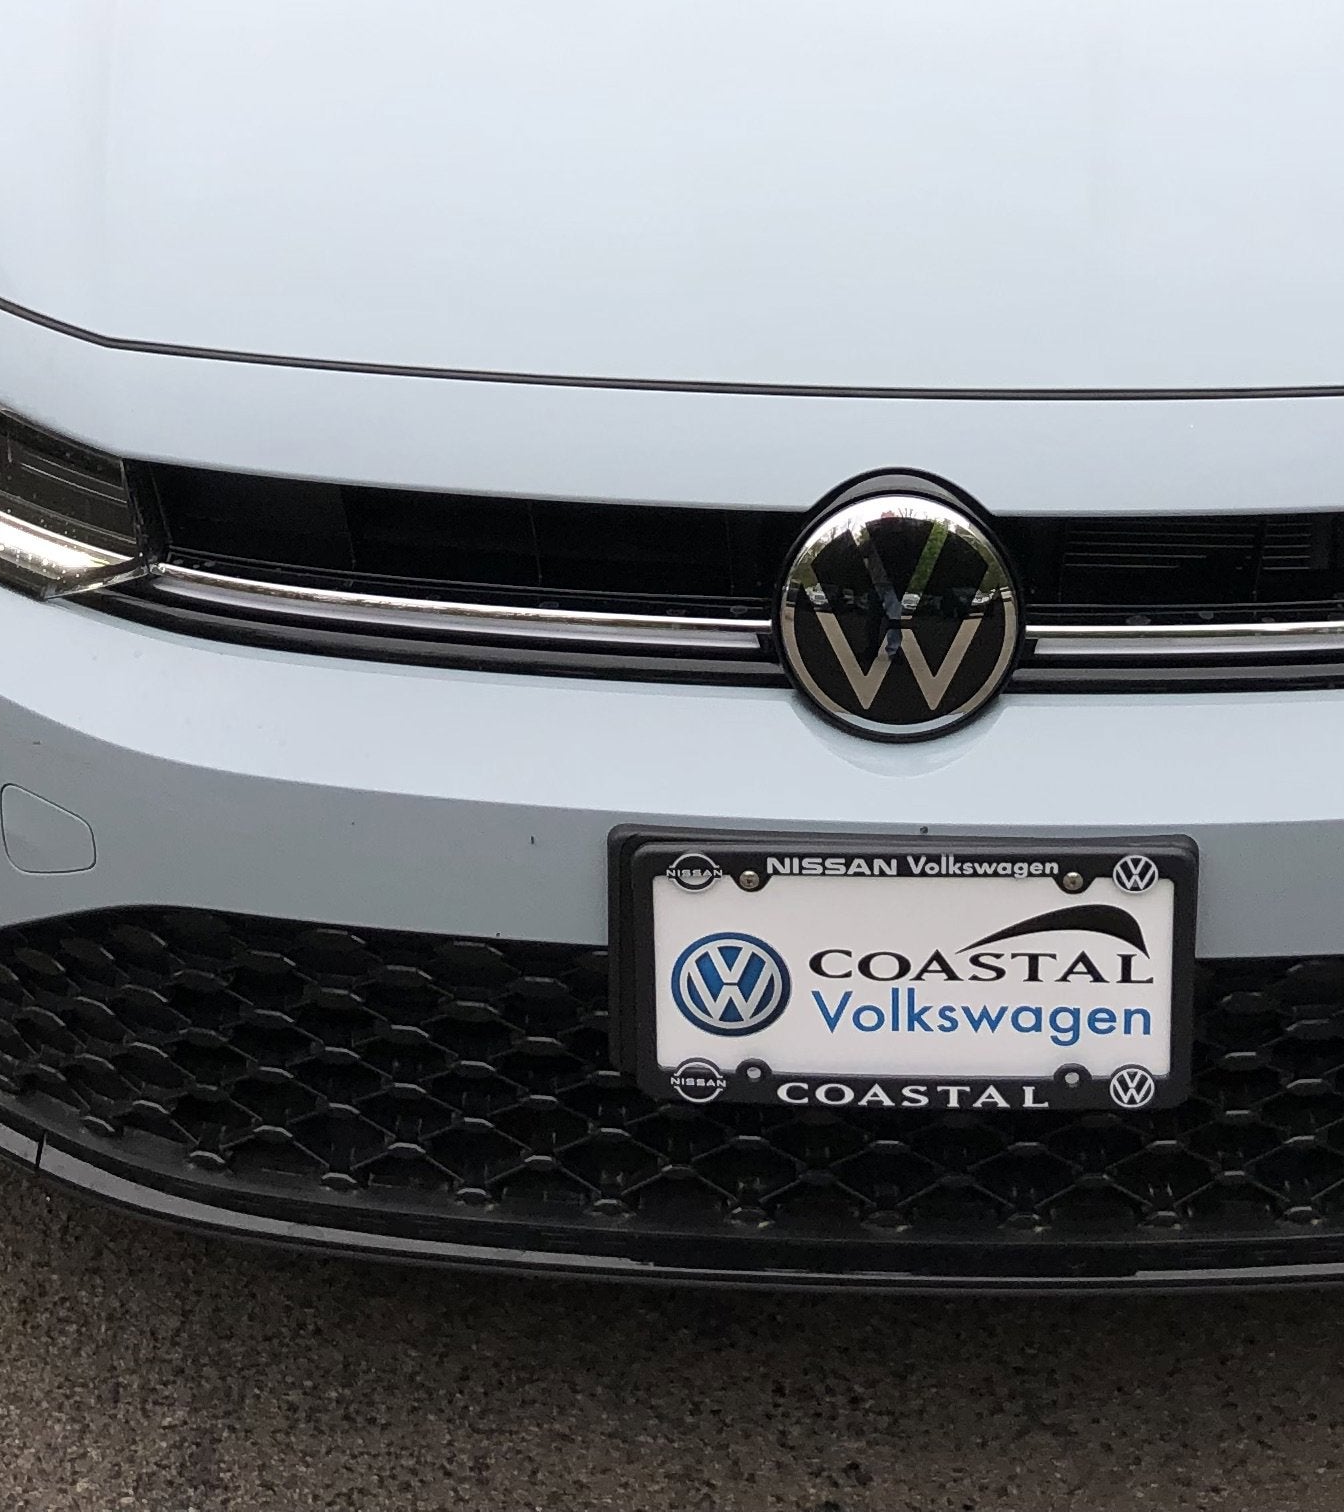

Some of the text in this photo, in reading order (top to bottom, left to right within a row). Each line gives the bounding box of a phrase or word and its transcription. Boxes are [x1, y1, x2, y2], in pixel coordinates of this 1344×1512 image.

[666, 868, 723, 879] NISSAN
[766, 855, 1059, 878] NISSAN Volkswagen
[809, 949, 1154, 984] COASTAL
[811, 987, 1152, 1047] Volkswagen
[670, 1076, 727, 1088] NISSAN
[776, 1082, 1049, 1108] COASTAL
